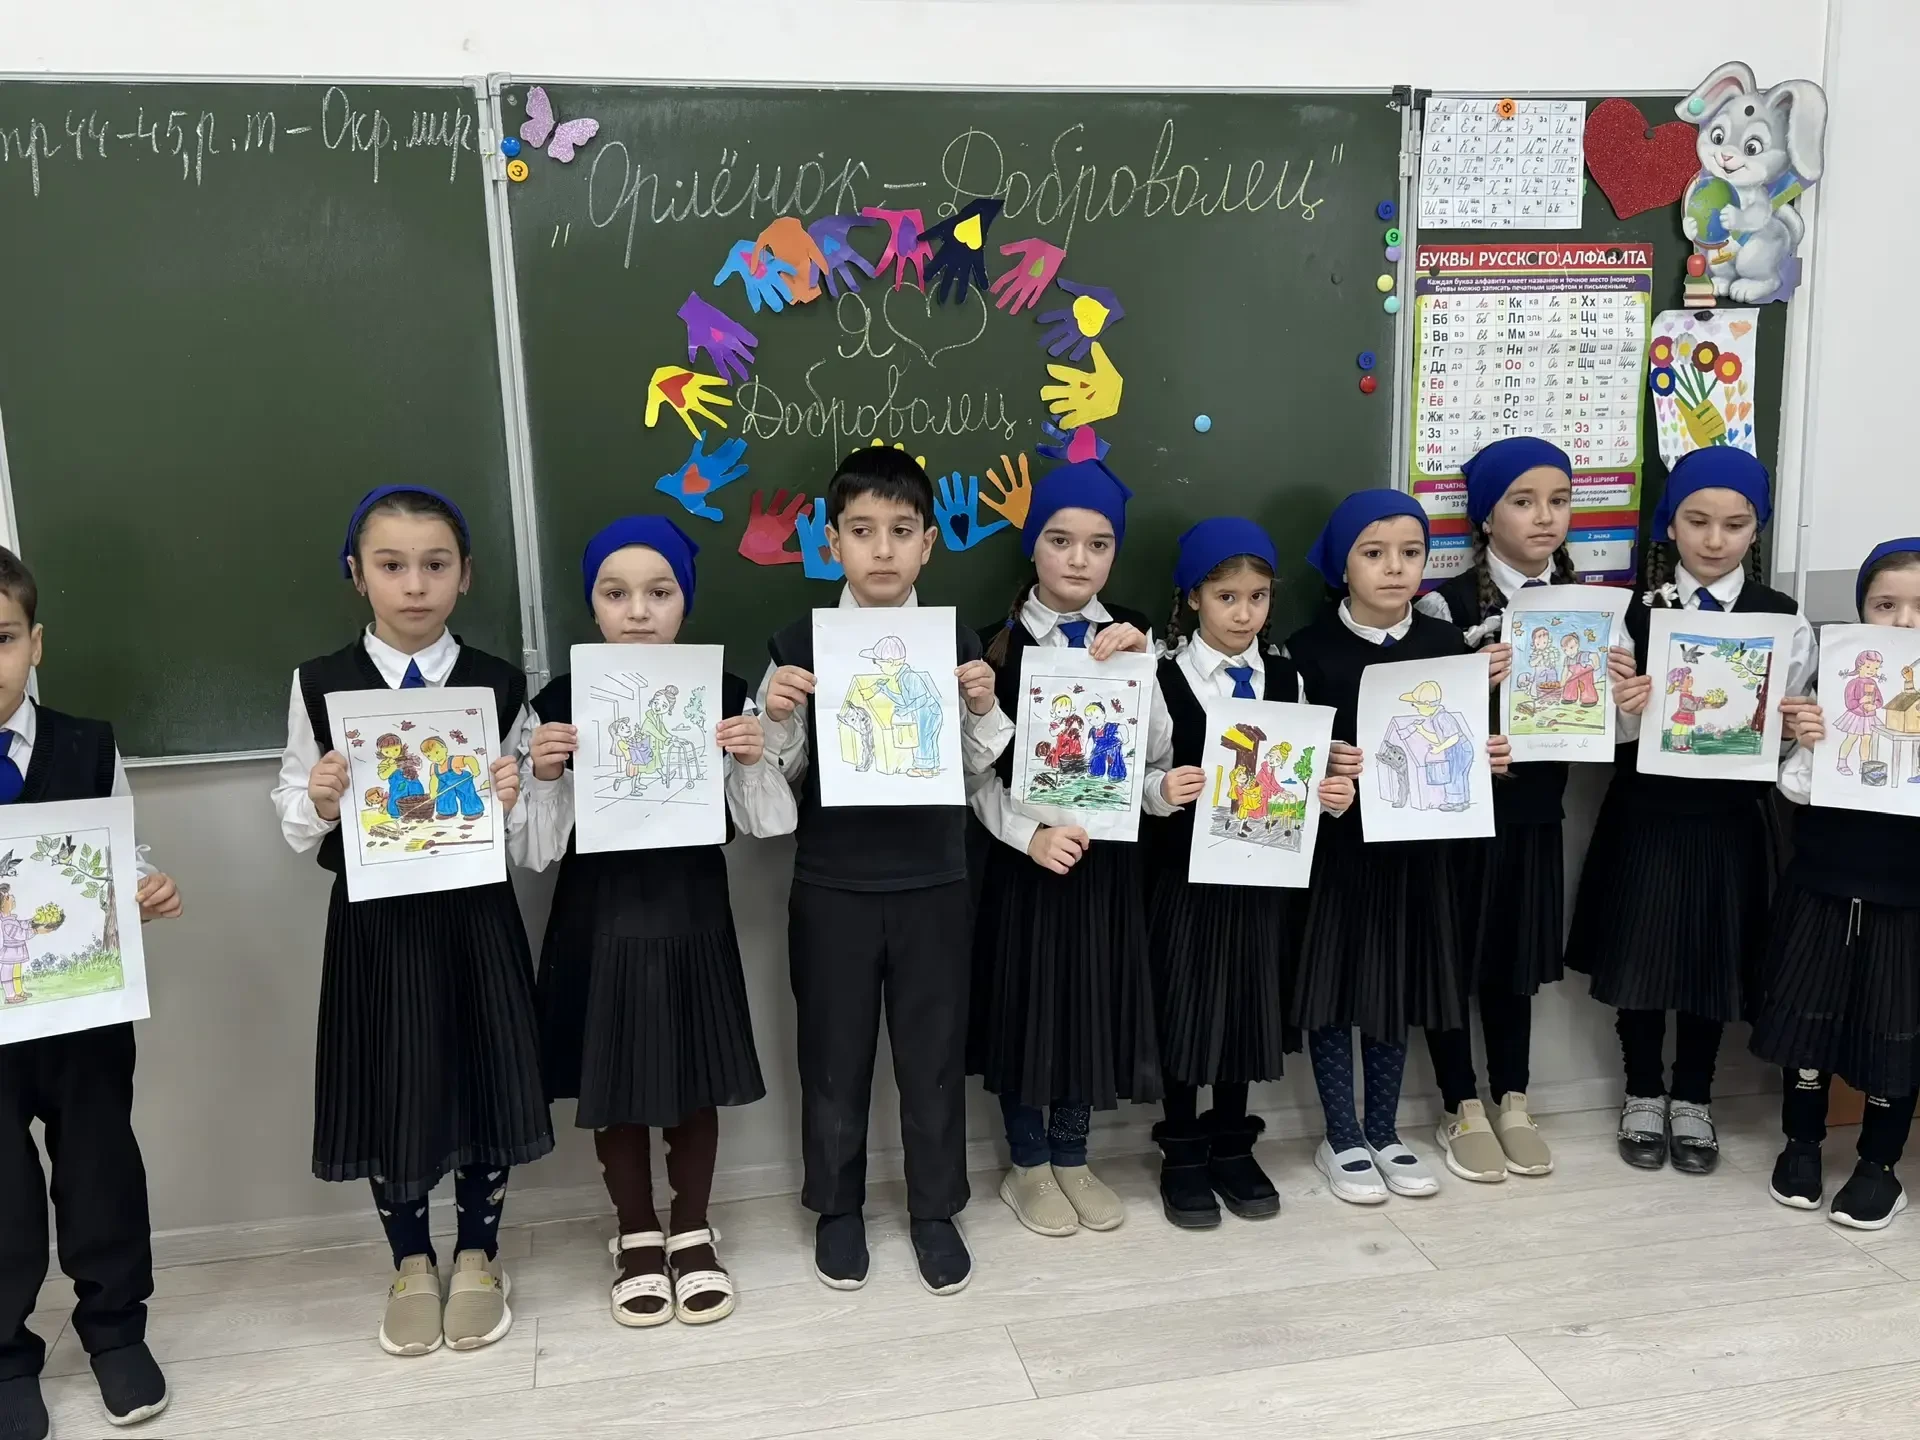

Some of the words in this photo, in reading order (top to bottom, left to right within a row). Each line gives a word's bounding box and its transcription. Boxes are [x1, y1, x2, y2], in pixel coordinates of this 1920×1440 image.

[1419, 251, 1474, 267] БУКВЫ
[1427, 278, 1453, 286] Каждая
[1454, 278, 1474, 287] буква
[1474, 278, 1506, 286] алфавита
[1546, 283, 1578, 291] шрифтом
[1433, 299, 1448, 309] Аа
[1509, 297, 1523, 308] Кк
[1581, 295, 1596, 307] Хх
[1432, 313, 1448, 325] Бб
[1508, 312, 1524, 323] Лл
[1581, 310, 1597, 324] Цц
[837, 290, 897, 359] Я
[1432, 330, 1448, 342] Вв
[1508, 328, 1525, 340] Мм
[1581, 327, 1597, 338] Чч
[1432, 346, 1444, 357] Гг
[1507, 344, 1523, 355] Нн
[1580, 342, 1597, 353] Шш
[1430, 361, 1446, 374] Дд
[1505, 359, 1522, 370] Оо
[1578, 357, 1595, 370] Щщ
[1430, 377, 1444, 389] Ее
[1505, 376, 1521, 387] Пп
[1429, 393, 1444, 406] Ёё
[1504, 393, 1520, 406] Рр
[1428, 411, 1444, 422] Жж
[1503, 408, 1519, 419] Сс
[1503, 424, 1516, 435] Тт
[1575, 421, 1589, 433] Ээ
[1428, 427, 1441, 439] Зз
[1427, 443, 1442, 454] Ии
[1573, 438, 1590, 448] Юю
[1427, 458, 1442, 472] Йй
[1574, 454, 1590, 465] Яя
[1593, 475, 1619, 483] ШРИФТ
